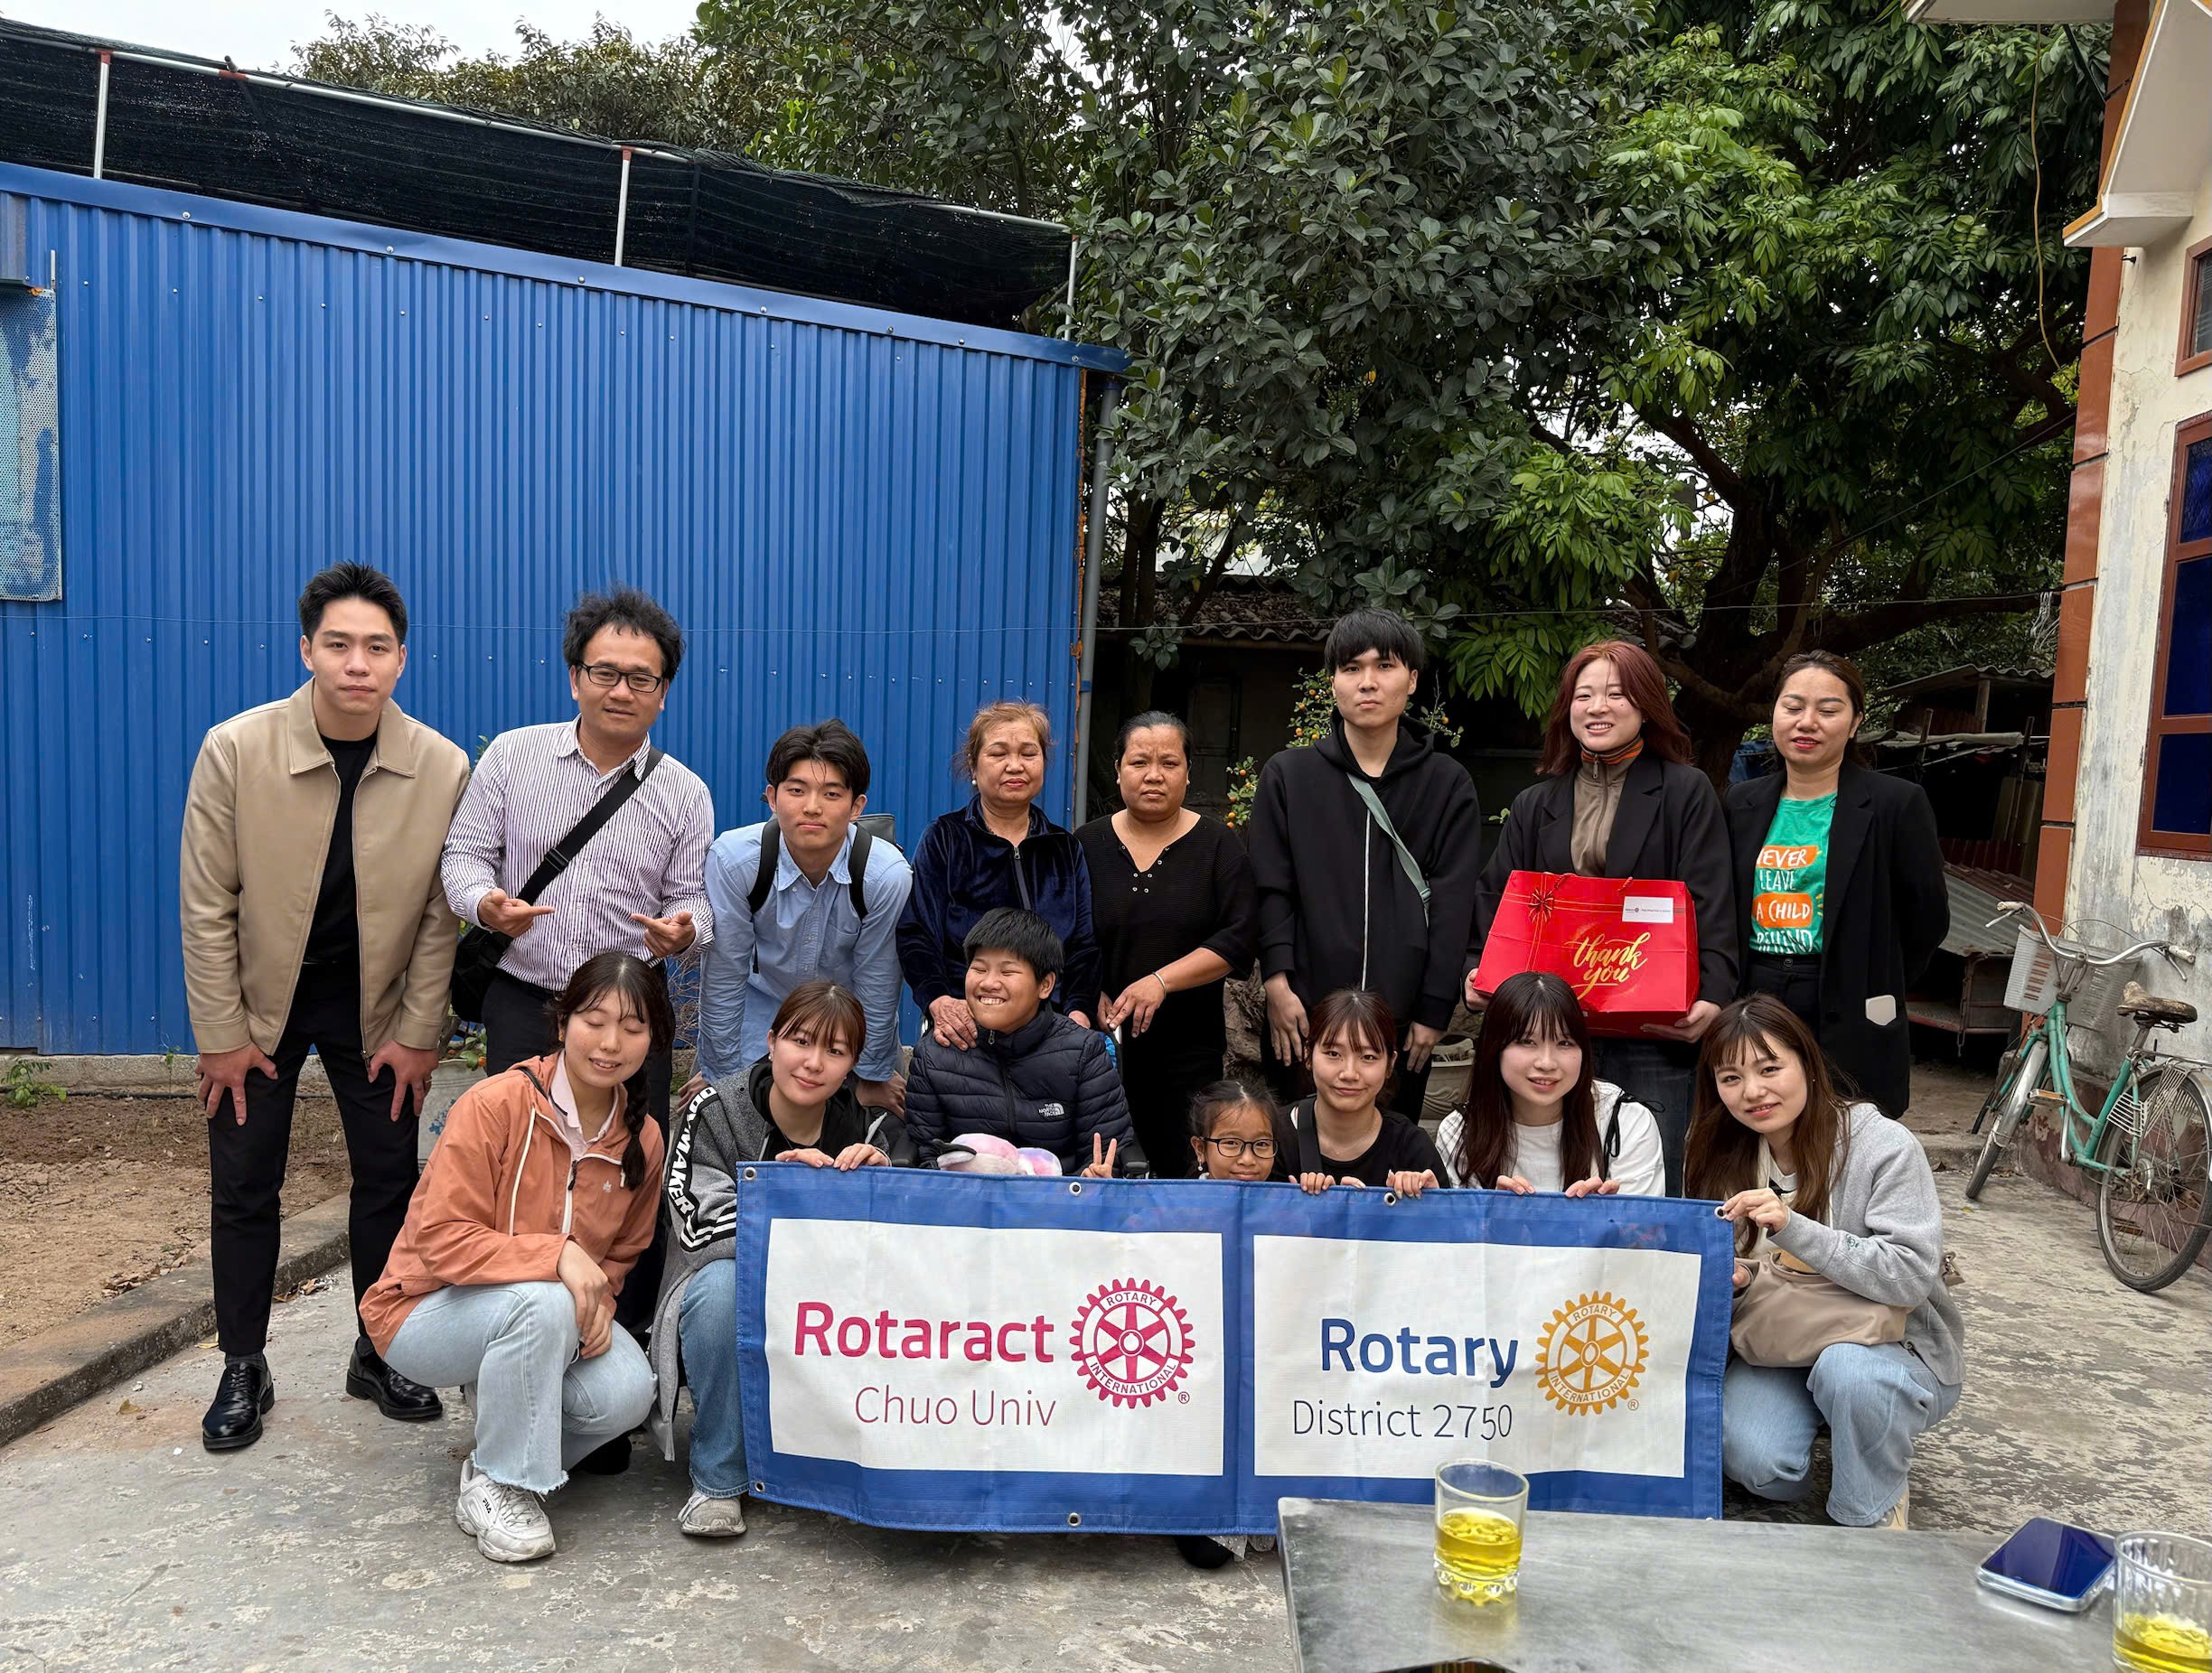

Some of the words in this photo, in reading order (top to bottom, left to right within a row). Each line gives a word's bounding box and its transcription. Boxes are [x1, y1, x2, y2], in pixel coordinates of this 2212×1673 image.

[1759, 870, 1796, 891] LEAVE
[1756, 902, 1764, 921] A
[1768, 900, 1811, 921] CHILD
[1564, 932, 1651, 970] thank
[1570, 966, 1630, 1000] you
[1106, 1292, 1157, 1306] ROTARY
[1573, 1304, 1617, 1322] ROTARY
[794, 1302, 1054, 1363] Rotaract
[1321, 1317, 1518, 1388] Rotary
[1090, 1361, 1176, 1394] INTERNATIONAL
[1551, 1374, 1629, 1403] INTERNATIONAL
[855, 1384, 958, 1425] Chuo
[971, 1389, 1056, 1426] Univ
[1294, 1399, 1422, 1438] District
[1434, 1404, 1513, 1441] 2750
[483, 1498, 492, 1514] FILA
